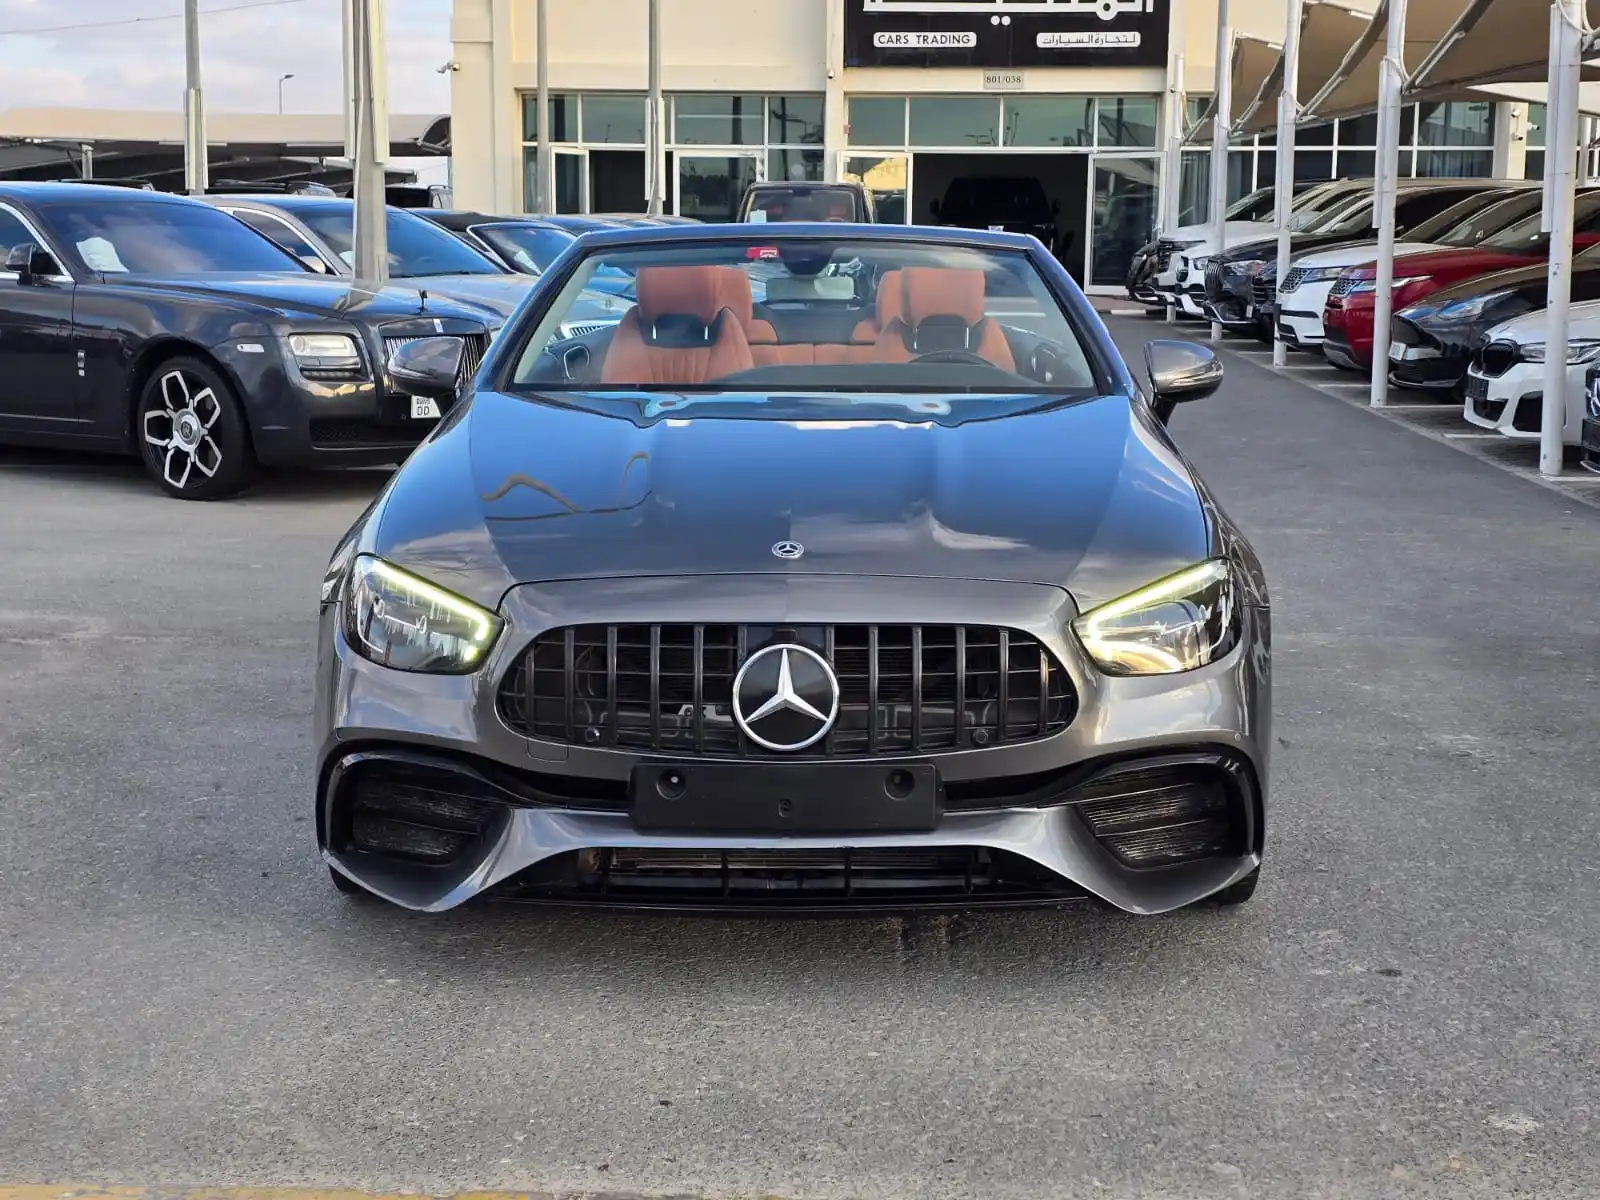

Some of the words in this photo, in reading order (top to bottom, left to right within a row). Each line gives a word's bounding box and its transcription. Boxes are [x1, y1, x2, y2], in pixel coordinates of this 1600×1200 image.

[878, 34, 909, 45] CARS
[916, 34, 970, 45] TRADING
[986, 75, 1022, 84] 801/038
